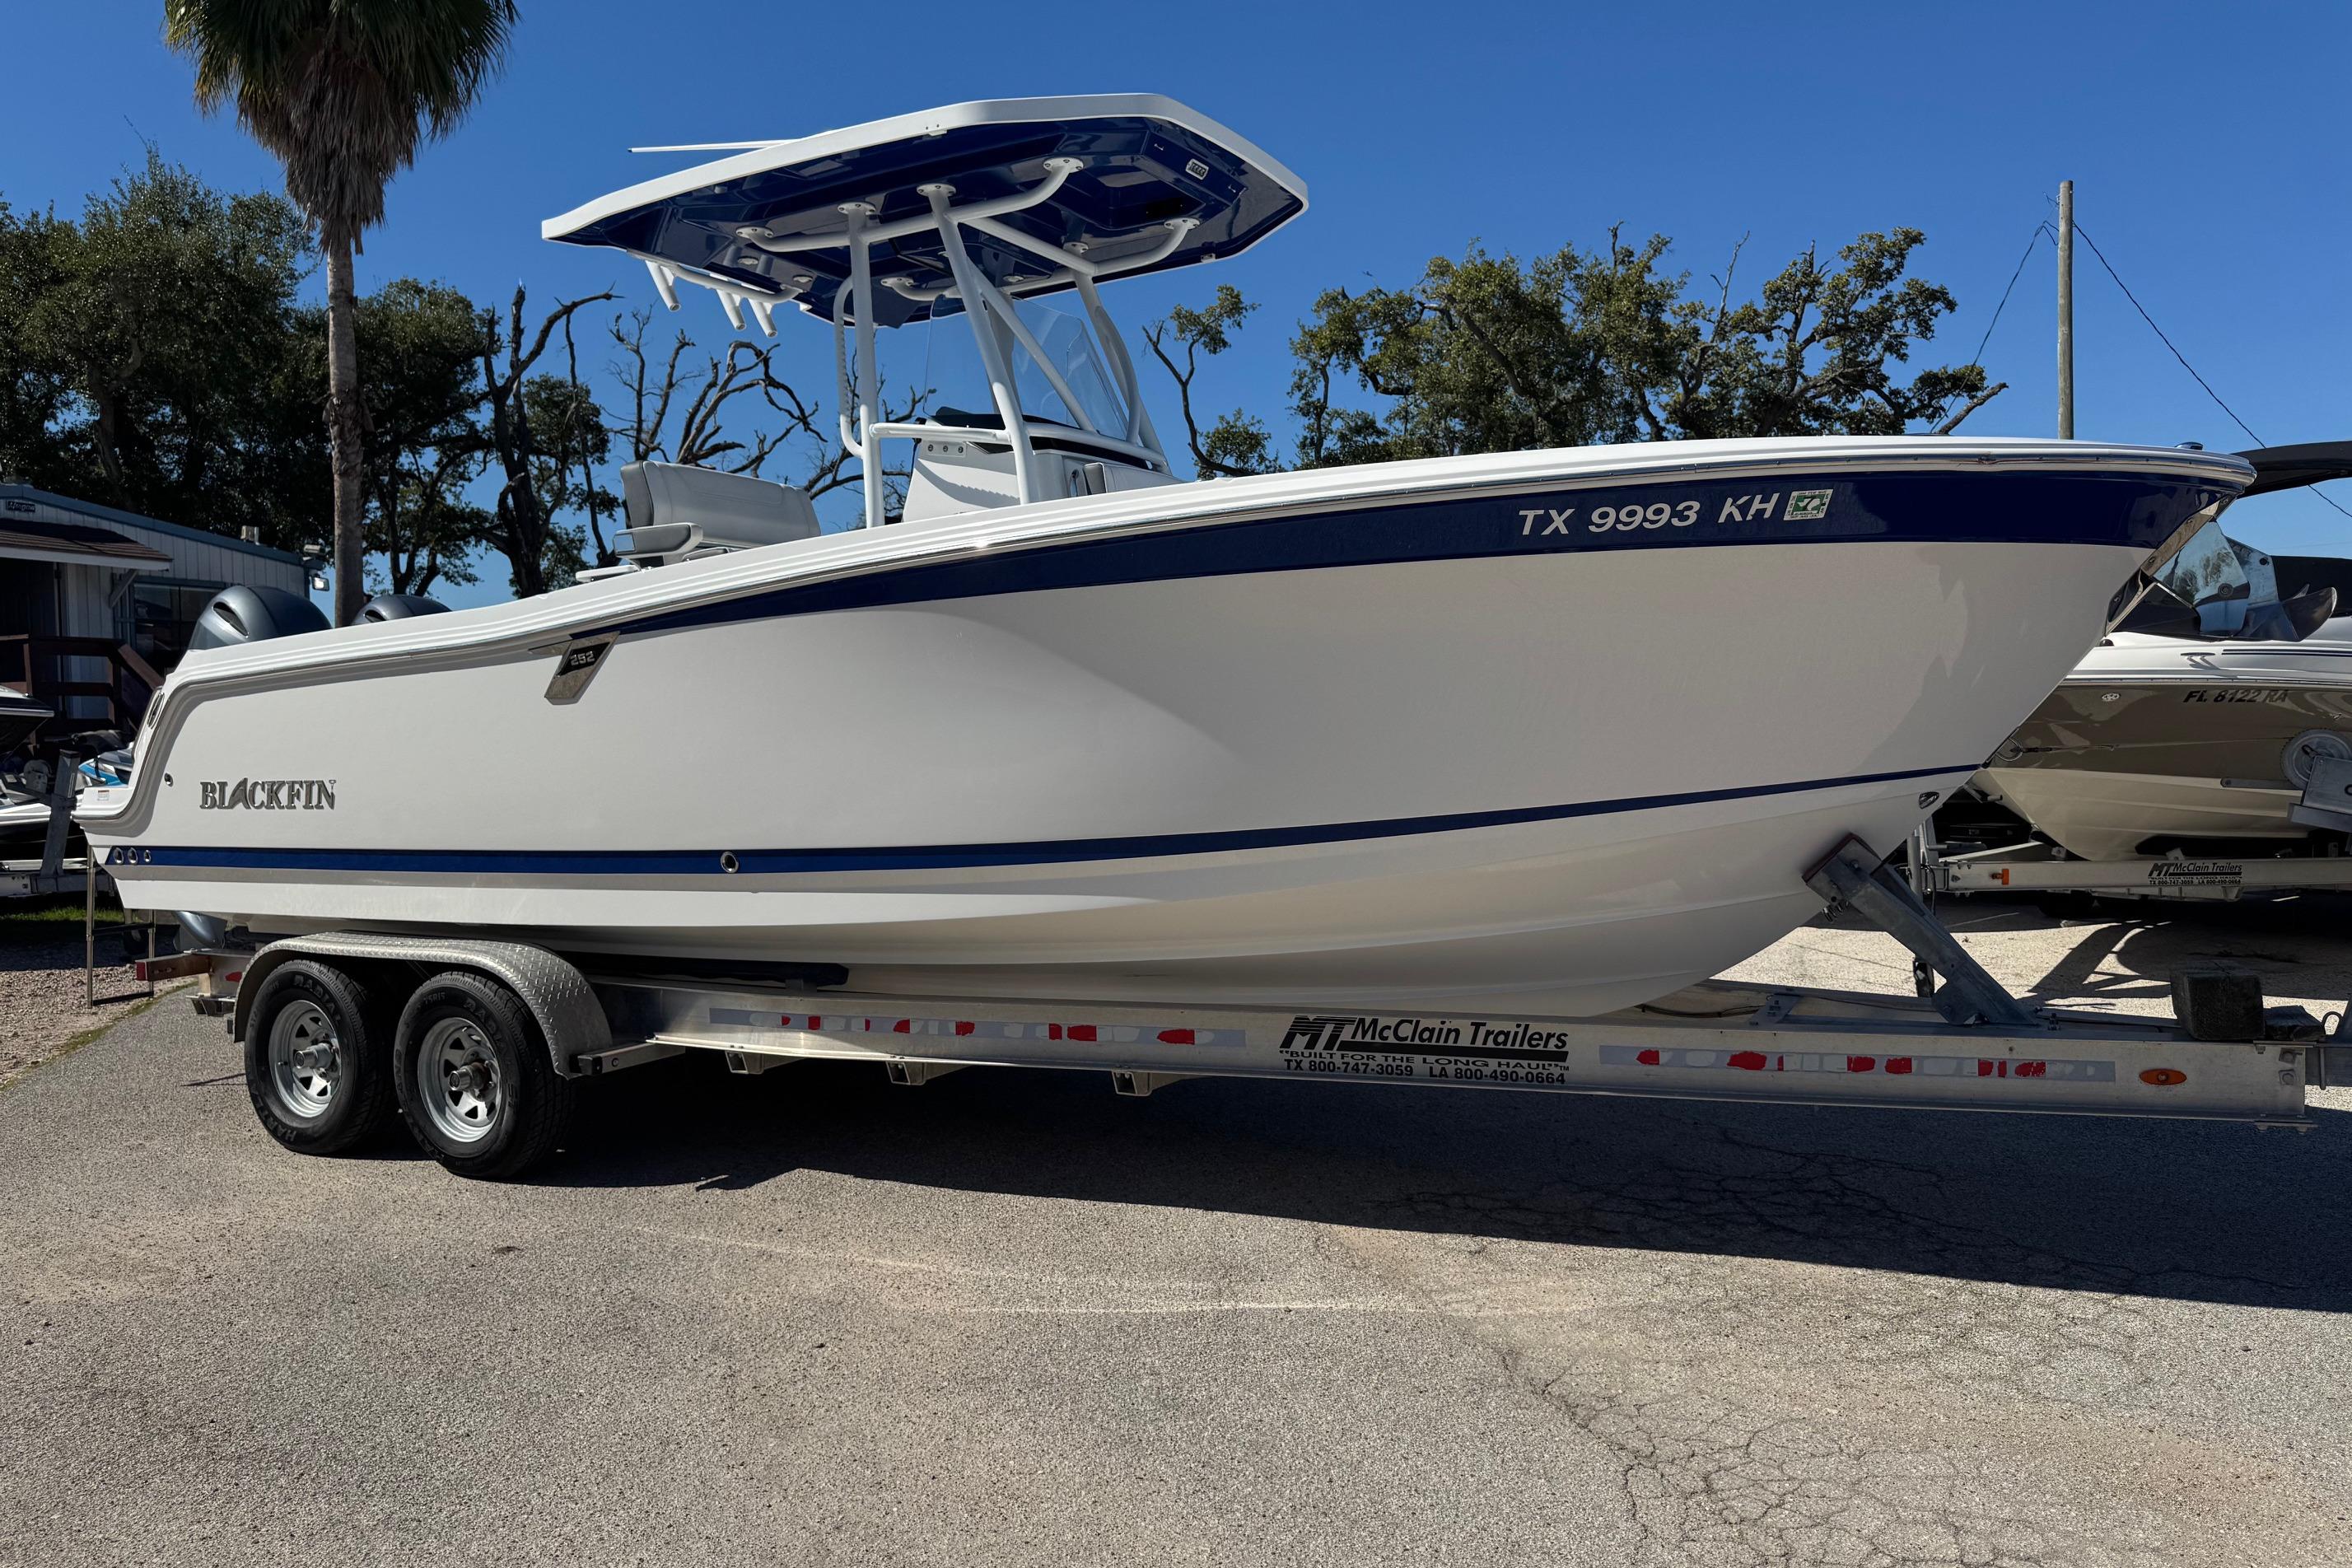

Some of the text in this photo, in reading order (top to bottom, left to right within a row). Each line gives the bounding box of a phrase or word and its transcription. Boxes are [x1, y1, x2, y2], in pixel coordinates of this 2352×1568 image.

[1518, 508, 1575, 536] TX
[1588, 501, 1701, 533] 9993
[1718, 492, 1780, 524] KH
[570, 651, 595, 666] 252
[2183, 690, 2207, 702] FL
[2213, 689, 2261, 702] 8122
[199, 777, 336, 810] BLACKFIN
[2172, 862, 2209, 872] McClain
[2211, 862, 2242, 872] Trailers
[1279, 1015, 1569, 1051] MT McClain Trailers
[1341, 1053, 1377, 1062] FOR
[1381, 1055, 1416, 1063] THE
[1422, 1057, 1489, 1067] LONG
[1284, 1058, 1566, 1085] TX 800-747-3059 LA 800-490-0664
